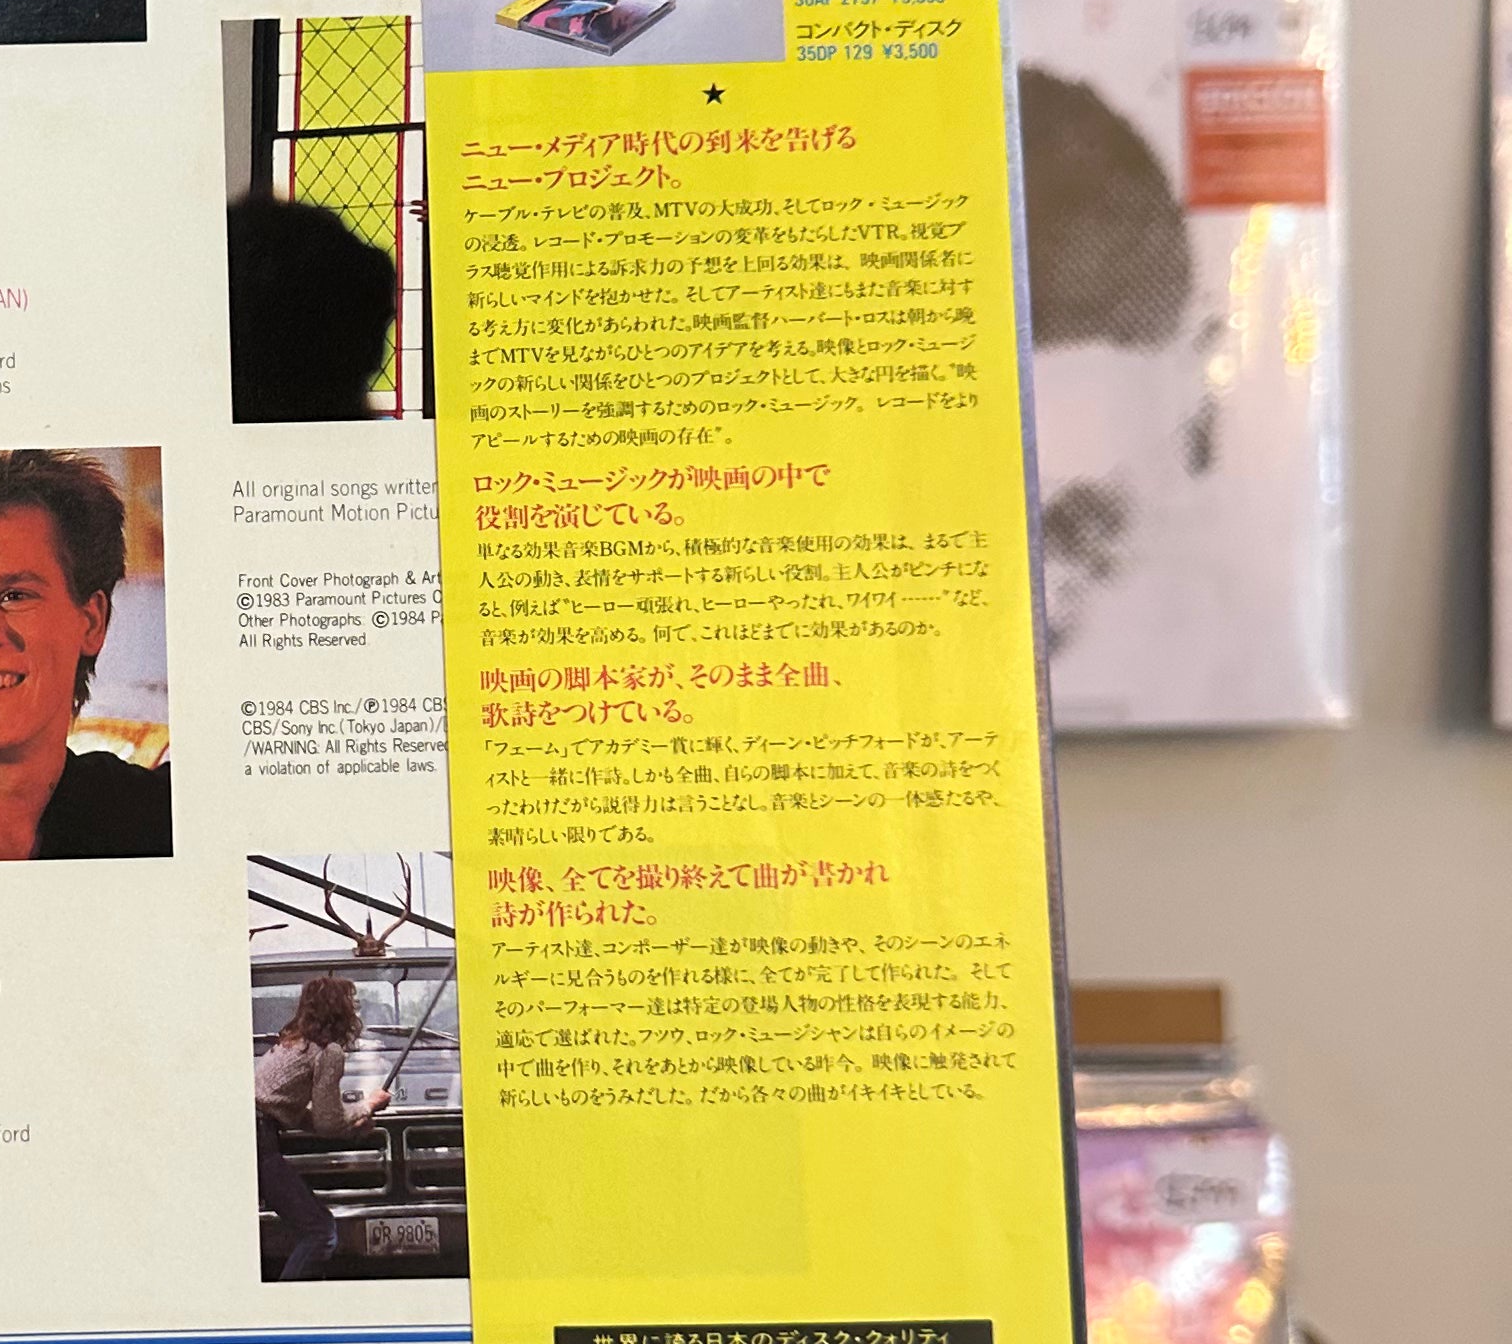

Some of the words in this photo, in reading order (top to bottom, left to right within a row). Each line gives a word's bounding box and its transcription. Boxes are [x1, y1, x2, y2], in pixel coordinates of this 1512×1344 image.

[796, 18, 963, 40] コンパクト・ディスク
[460, 124, 857, 159] ニュー・メディア時代の到来を告げる
[473, 462, 831, 495] ロック・ミュージックが映画の中で
[475, 501, 685, 531] 役割を演じている。
[244, 764, 253, 776] a
[258, 760, 312, 776] violation
[316, 759, 330, 775] of
[336, 758, 400, 776] applicable
[406, 757, 437, 773] laws.
[488, 859, 890, 894] 映像、全てを撮り終えて曲が書かれ
[491, 899, 657, 929] 詩が作られた。
